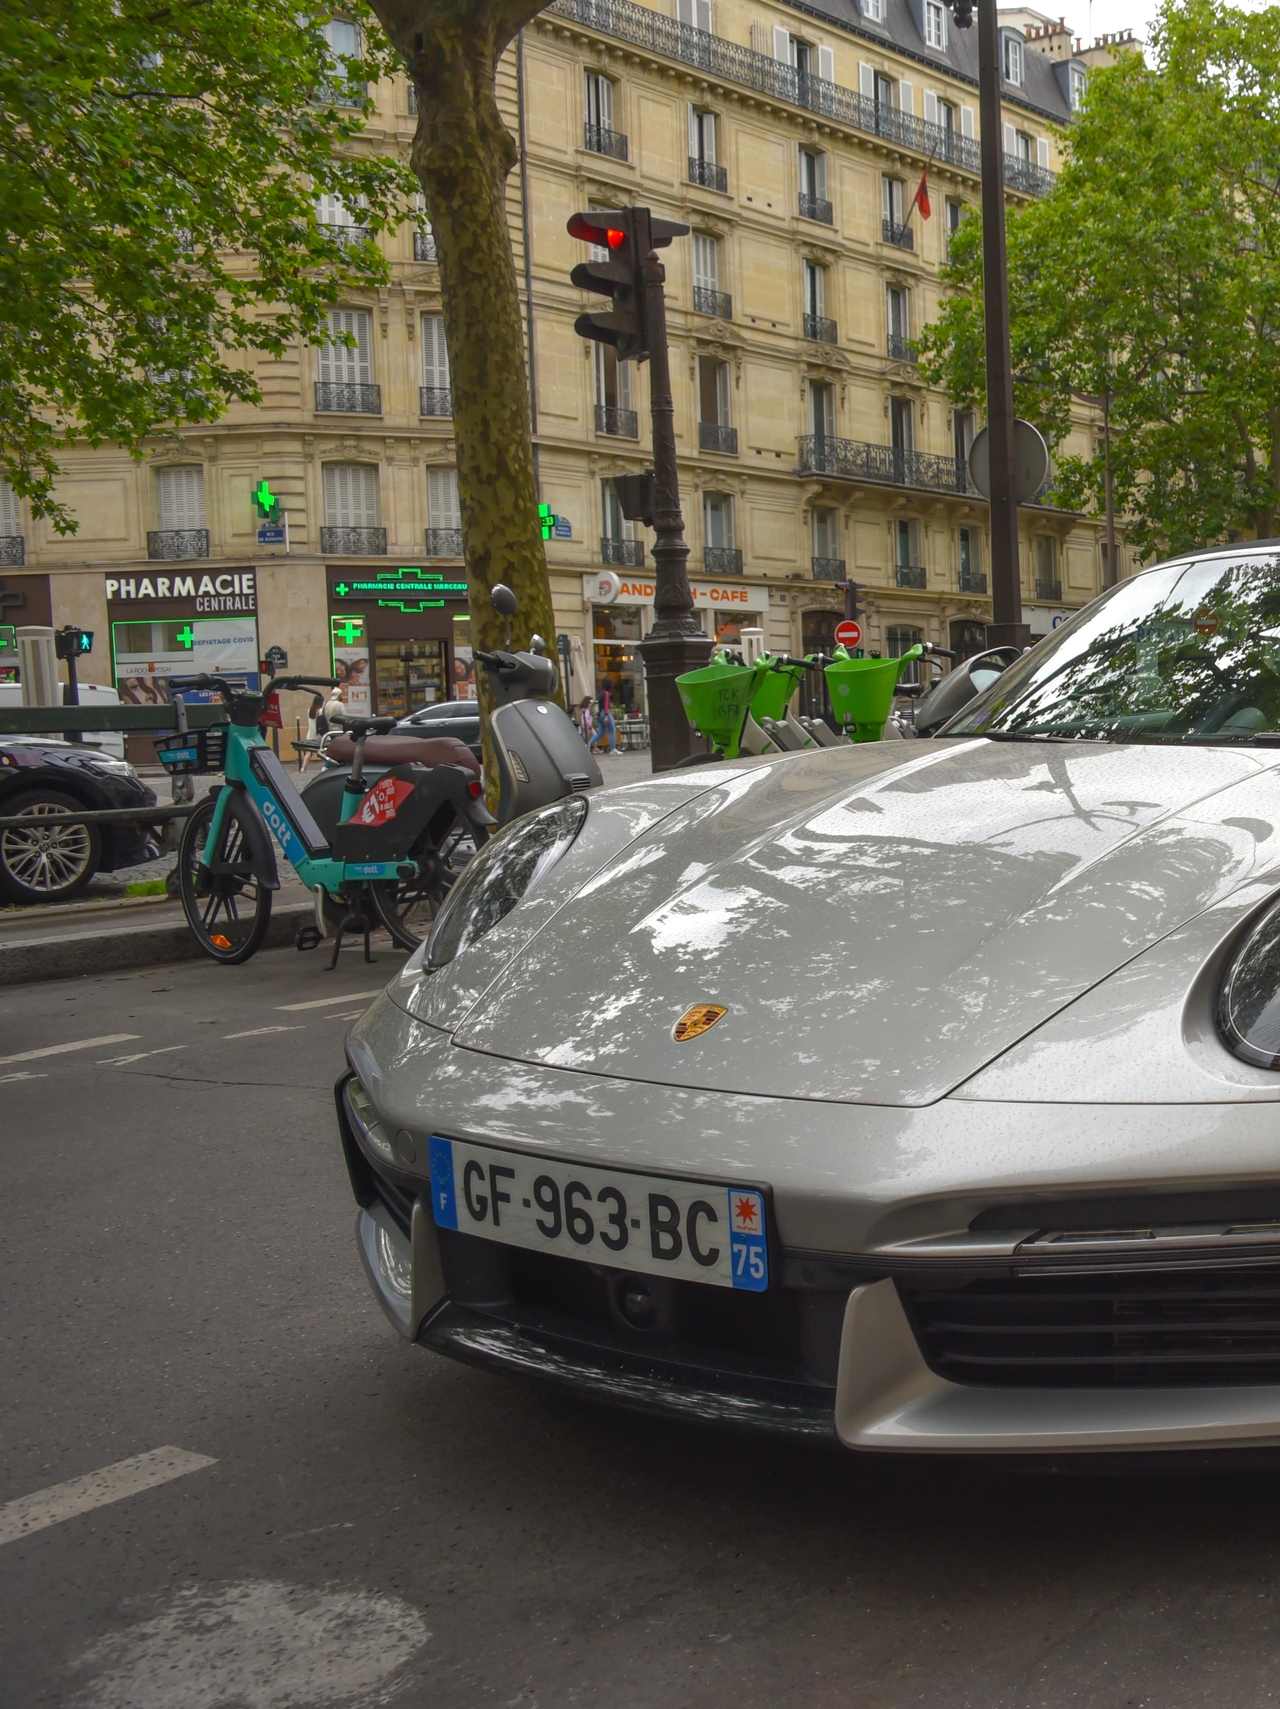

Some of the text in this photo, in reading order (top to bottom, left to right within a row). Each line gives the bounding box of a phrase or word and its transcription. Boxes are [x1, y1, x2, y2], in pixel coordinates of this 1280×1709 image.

[105, 574, 255, 599] PHARMACIE
[353, 582, 395, 590] PHARMACIE
[196, 595, 256, 612] CENTRALE
[709, 587, 749, 603] CAFÉ
[233, 636, 254, 644] COVID
[263, 801, 291, 847] dott
[363, 865, 379, 874] dott
[440, 1192, 448, 1210] F
[463, 1159, 720, 1267] GF-963-BC
[733, 1243, 765, 1279] 75
